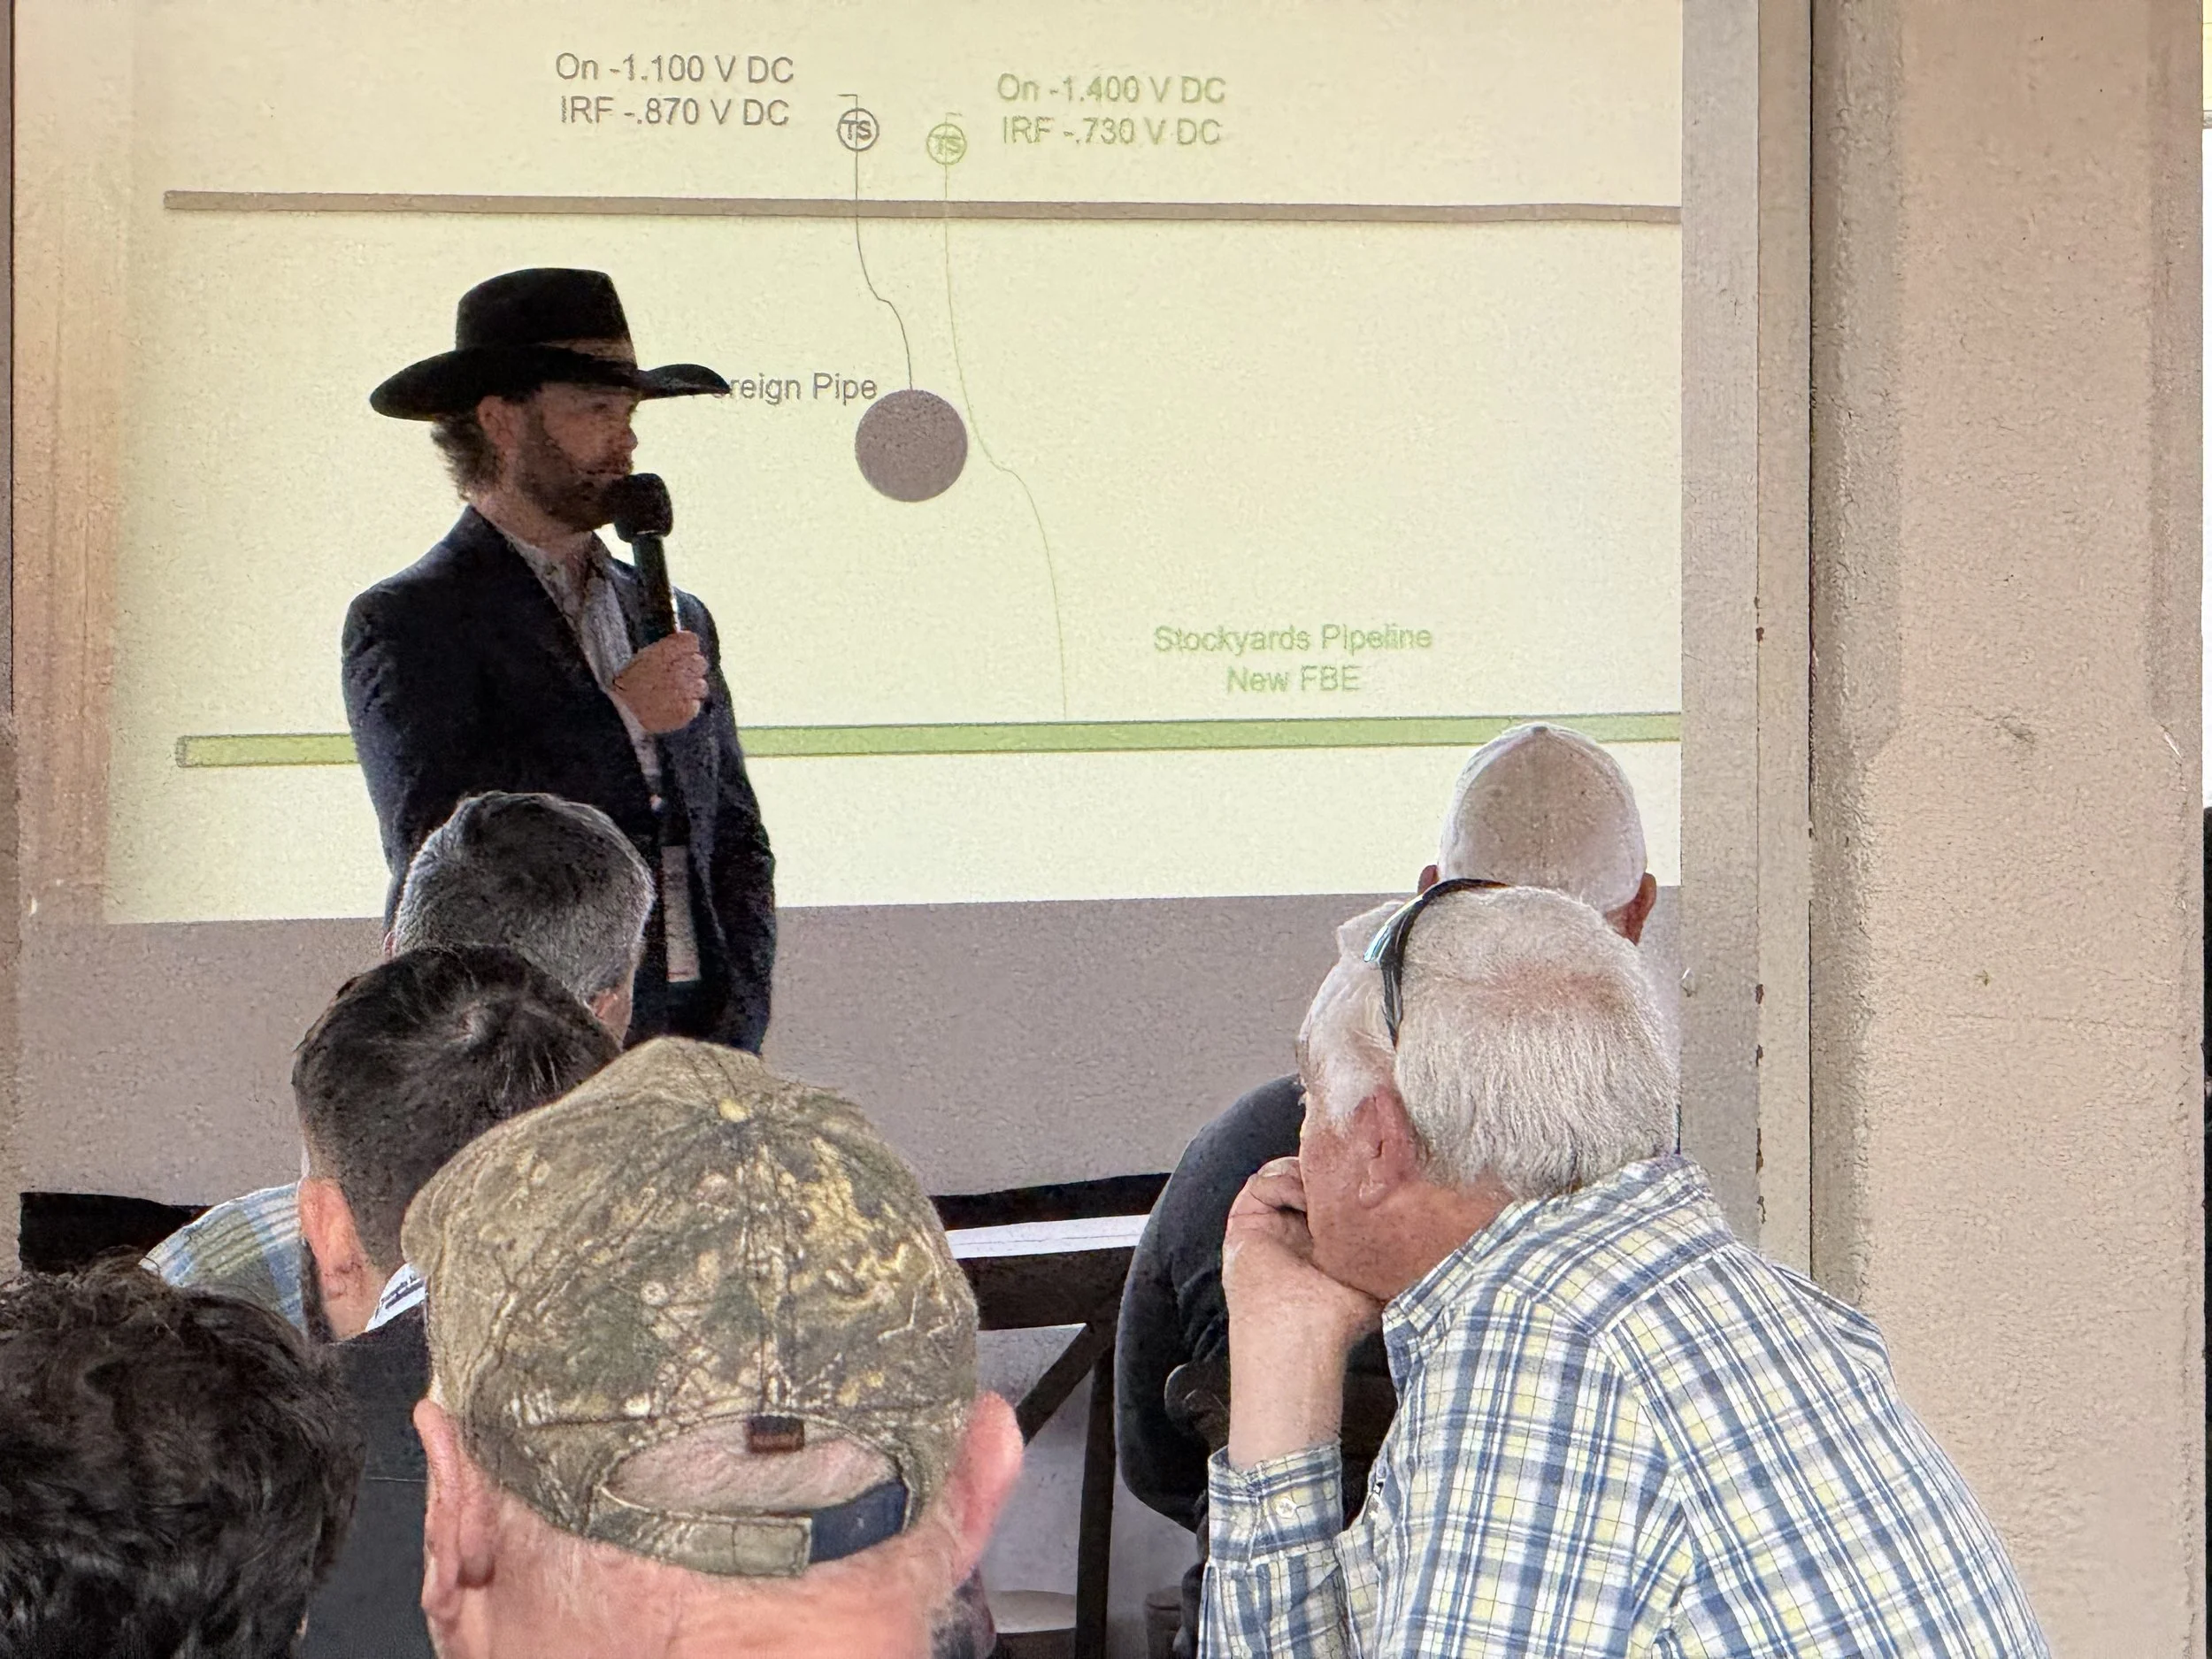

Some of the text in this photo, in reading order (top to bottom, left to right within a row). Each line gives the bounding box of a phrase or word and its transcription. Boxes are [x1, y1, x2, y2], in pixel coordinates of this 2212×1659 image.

[556, 52, 794, 83] On -1.100 V DC
[997, 73, 1225, 104] On -1.400 V DC
[560, 95, 789, 126] IRF -.870 V DC
[841, 120, 872, 141] TS
[1003, 117, 1221, 146] IRF -.730 V DC
[703, 373, 877, 406] reign Pipe
[1154, 623, 1432, 656] Stockyards Pipeline
[1227, 665, 1362, 693] New FBE
